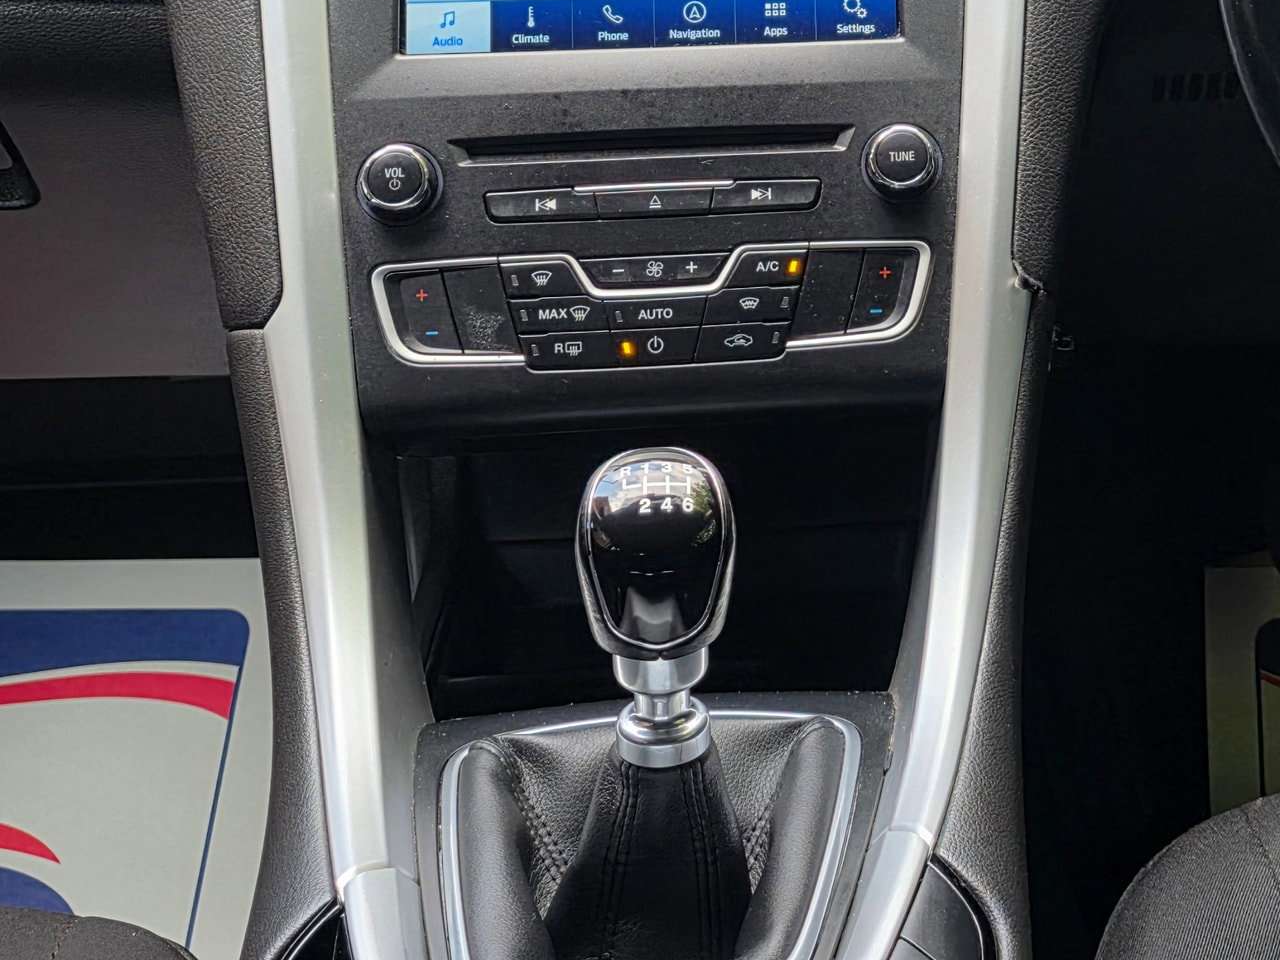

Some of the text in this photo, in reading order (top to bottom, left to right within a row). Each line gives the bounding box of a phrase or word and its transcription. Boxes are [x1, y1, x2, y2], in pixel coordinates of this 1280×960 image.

[669, 28, 720, 40] Navigation
[763, 26, 788, 37] Apps
[836, 23, 876, 35] Settings
[432, 36, 463, 47] Audio
[512, 33, 550, 44] Climate
[598, 31, 629, 41] Phone
[888, 150, 915, 162] TUNE
[384, 167, 405, 179] VOL
[756, 260, 779, 274] A/C
[537, 307, 568, 320] MAX
[638, 307, 673, 321] AUTO
[554, 342, 565, 355] R
[660, 463, 672, 473] 3
[639, 498, 694, 513] 2 4 6
